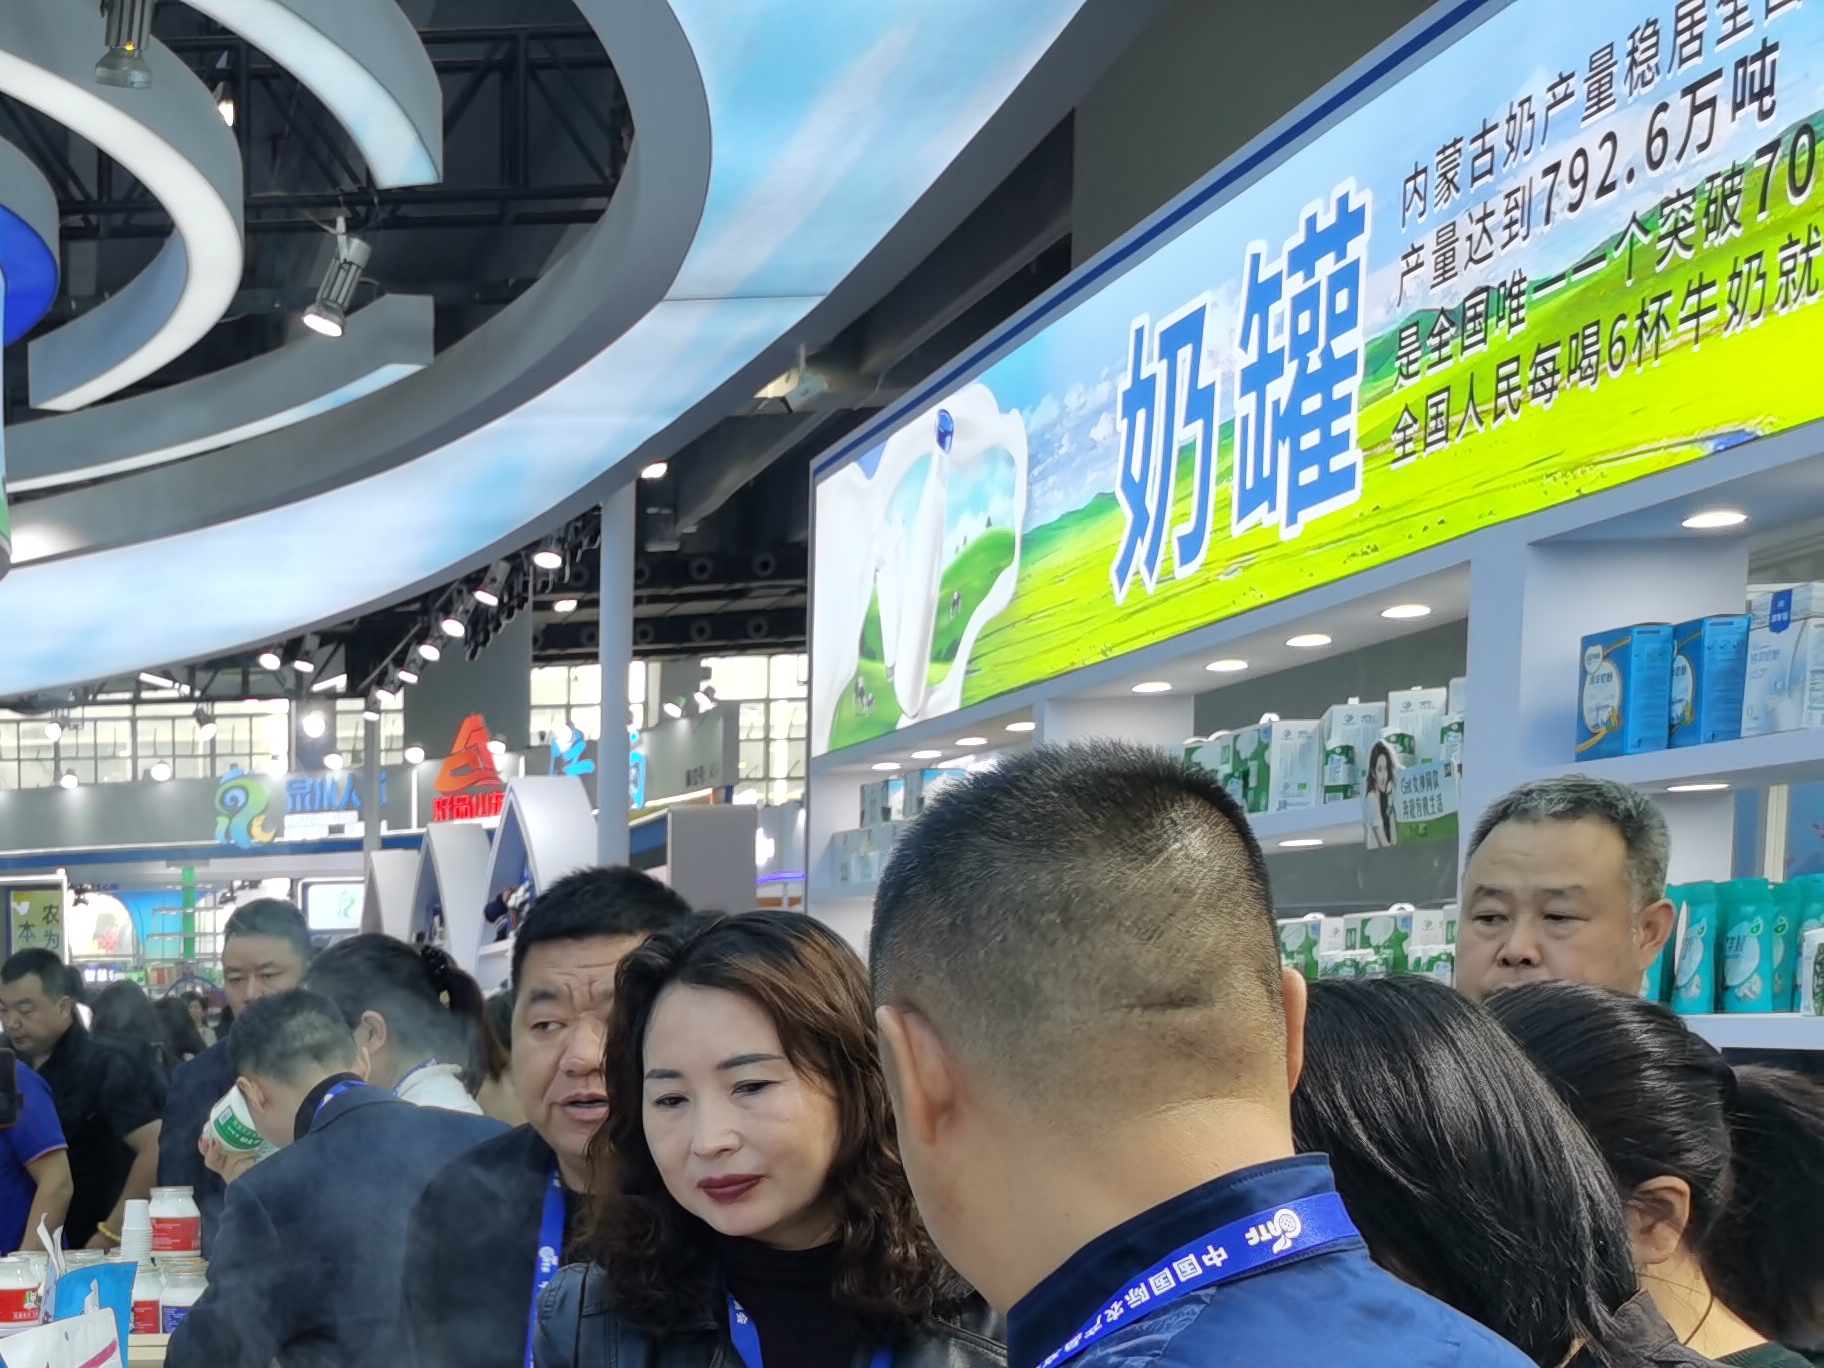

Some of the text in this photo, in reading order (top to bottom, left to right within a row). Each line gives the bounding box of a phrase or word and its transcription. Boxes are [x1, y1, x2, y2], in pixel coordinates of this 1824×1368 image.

[1394, 123, 1816, 388] 是全国唯一一个突破70
[1397, 37, 1780, 308] 产量达到792.6万吨
[1113, 180, 1370, 595] 奶罐
[1390, 225, 1822, 468] 全国人民每喝6杯牛奶就
